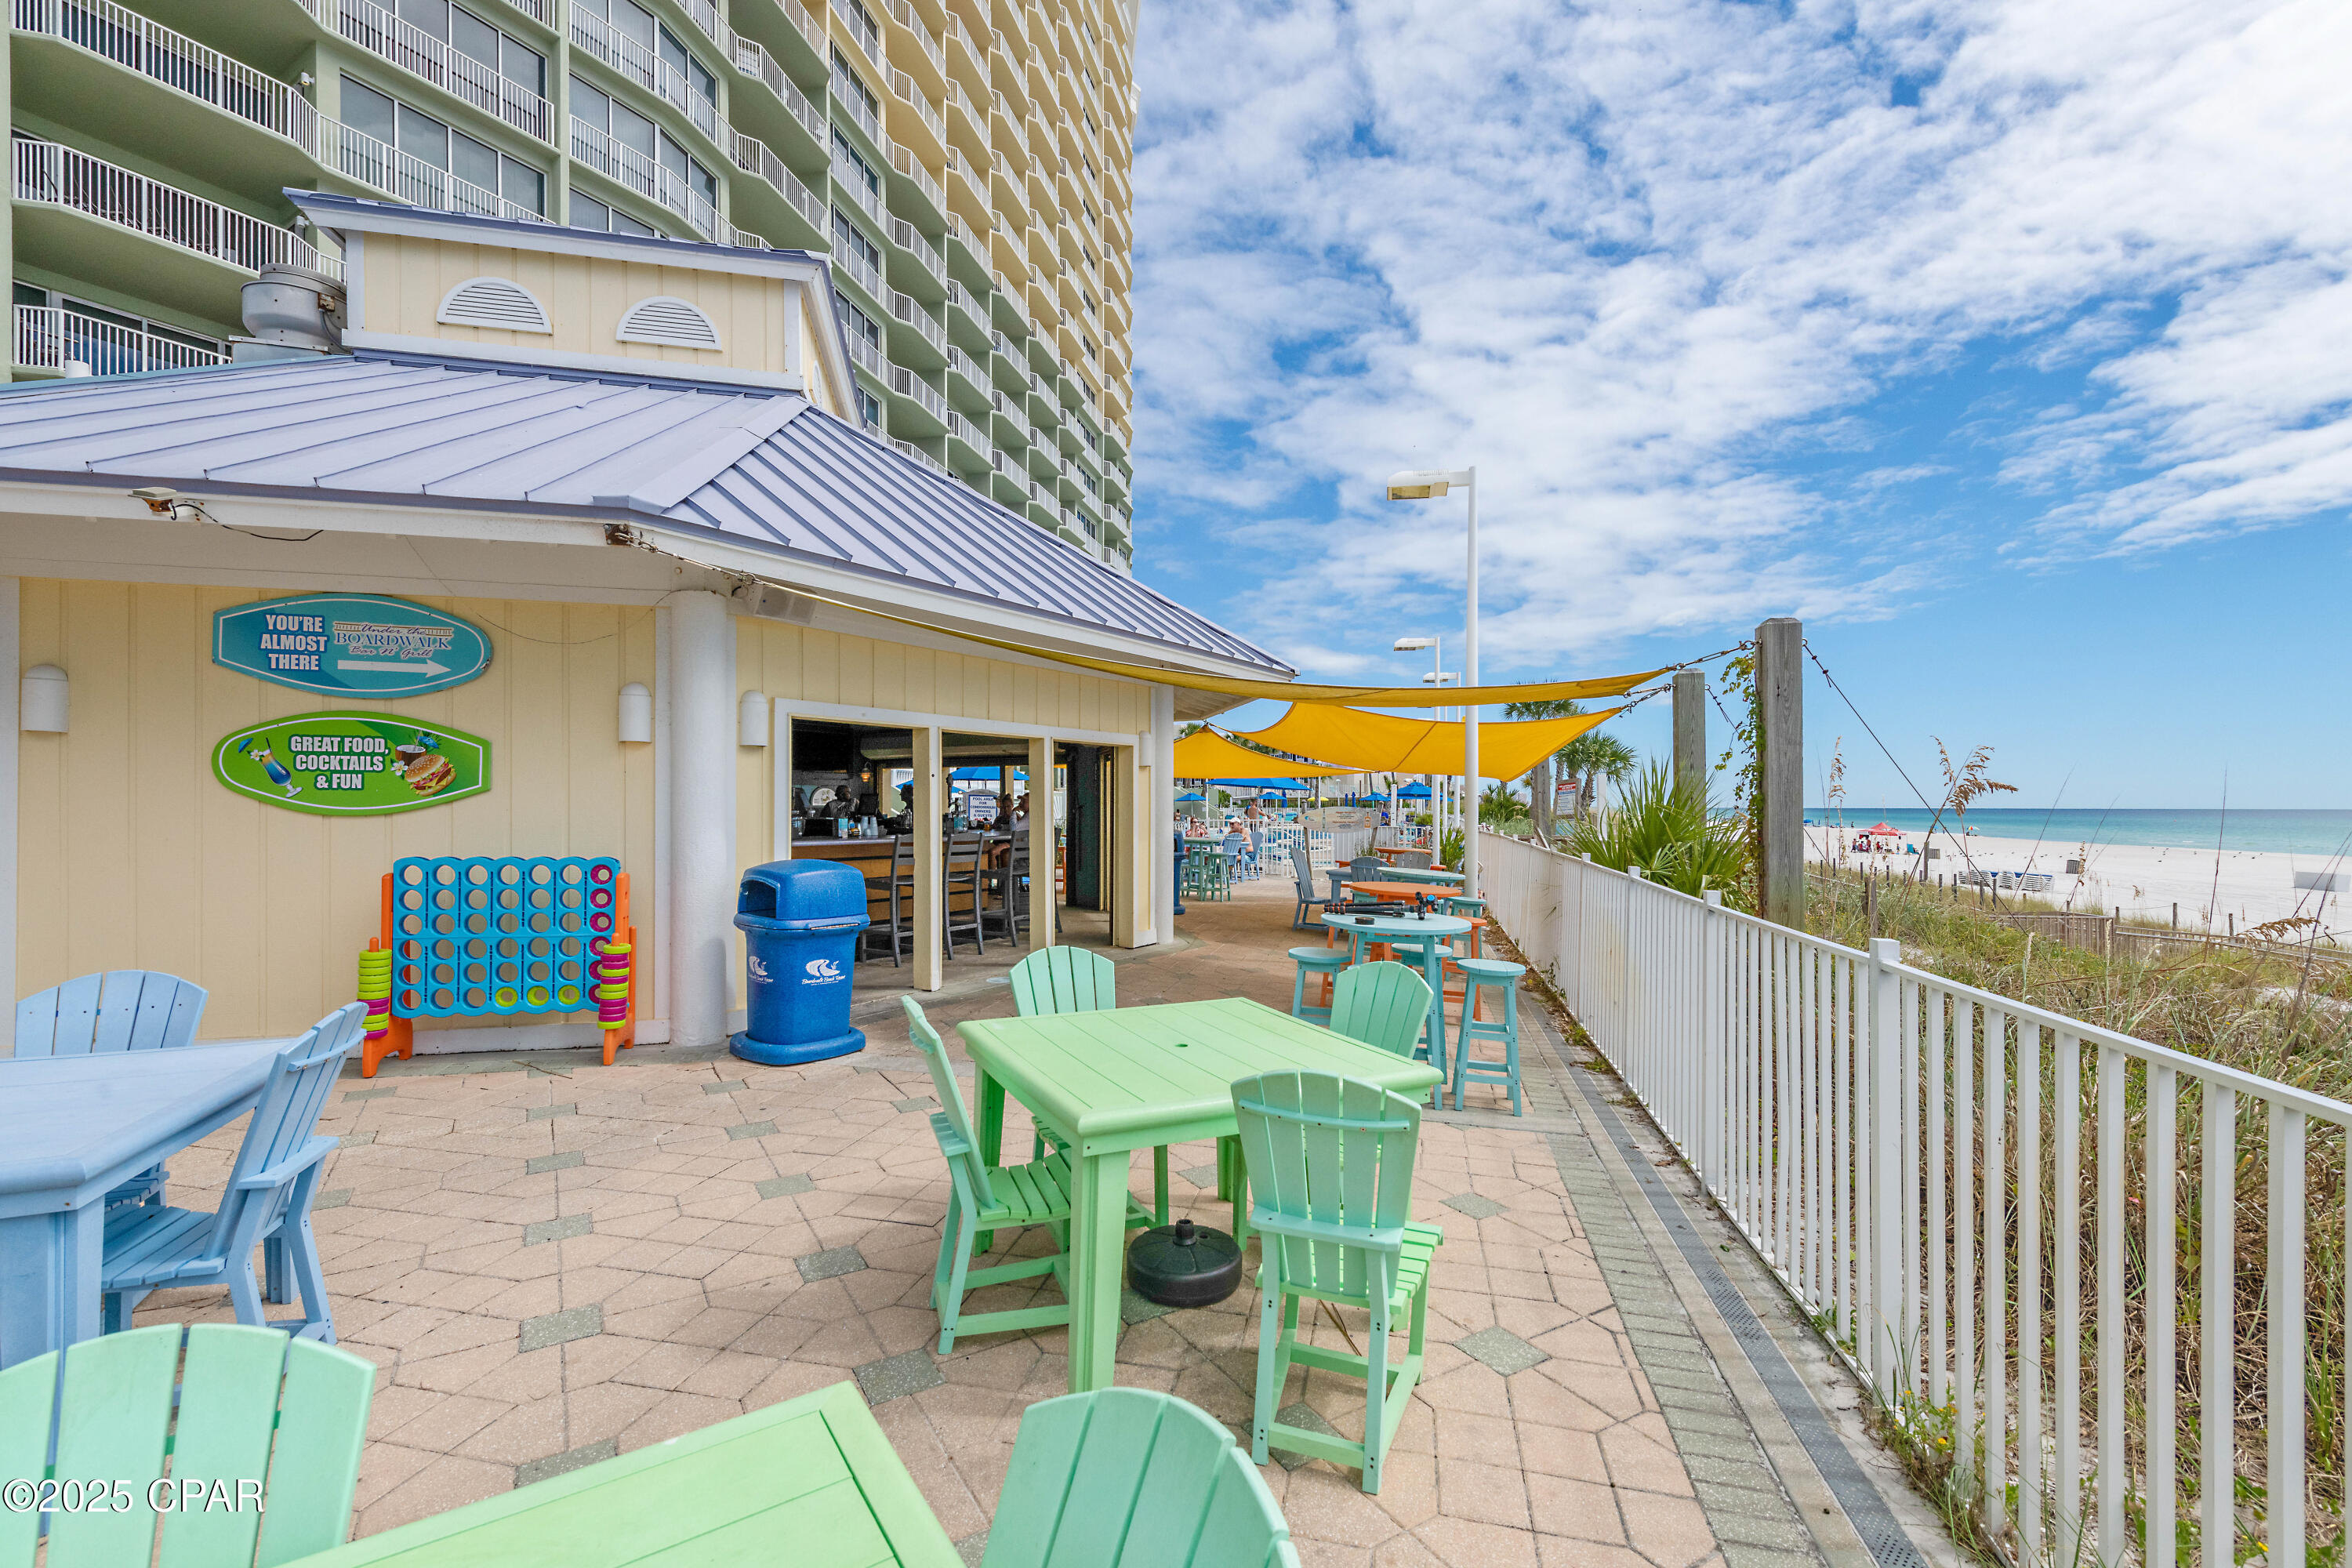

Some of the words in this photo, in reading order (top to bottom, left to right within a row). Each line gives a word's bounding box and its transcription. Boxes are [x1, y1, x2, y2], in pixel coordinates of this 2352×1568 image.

[266, 615, 323, 632] YOU'RE
[361, 623, 402, 633] Under
[407, 626, 426, 636] the
[260, 634, 328, 652] ALMOST
[336, 632, 449, 649] BOARDWALK
[350, 645, 376, 655] Bar
[401, 648, 433, 659] Grill
[268, 653, 319, 670] THERE
[291, 736, 341, 752] GREAT
[344, 737, 389, 754] FOOD,
[296, 754, 383, 771] COCKTAILS
[316, 775, 329, 789] &
[332, 773, 362, 789] FUN
